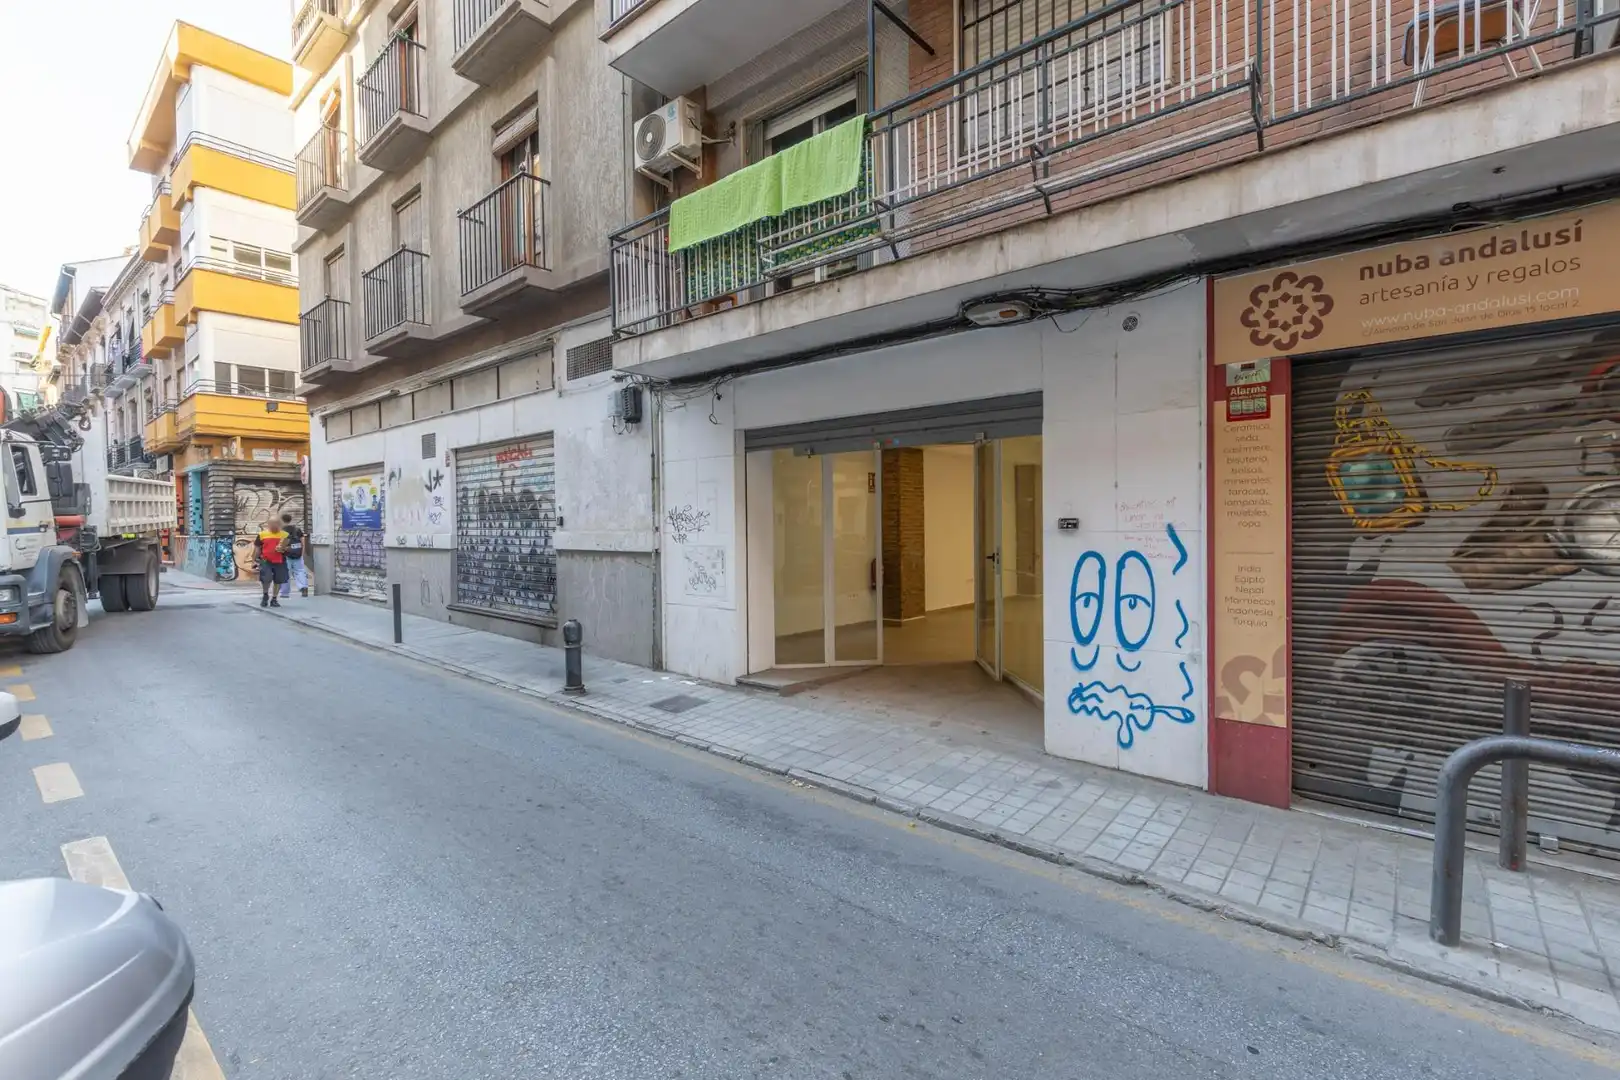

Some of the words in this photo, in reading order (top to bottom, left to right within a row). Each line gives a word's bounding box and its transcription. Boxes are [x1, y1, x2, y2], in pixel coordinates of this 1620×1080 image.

[1359, 254, 1430, 280] nuba
[1438, 218, 1584, 266] andalusí
[1358, 273, 1461, 305] artesanía
[1465, 273, 1480, 291] y
[1486, 256, 1582, 289] regalos
[1230, 385, 1268, 395] Alarma
[1238, 521, 1261, 529] ropa
[1237, 564, 1261, 573] India
[1234, 575, 1265, 584] Egipto
[1235, 585, 1264, 596] Nepal
[1224, 595, 1276, 606] Marruecos
[1226, 606, 1274, 617] Indonesia
